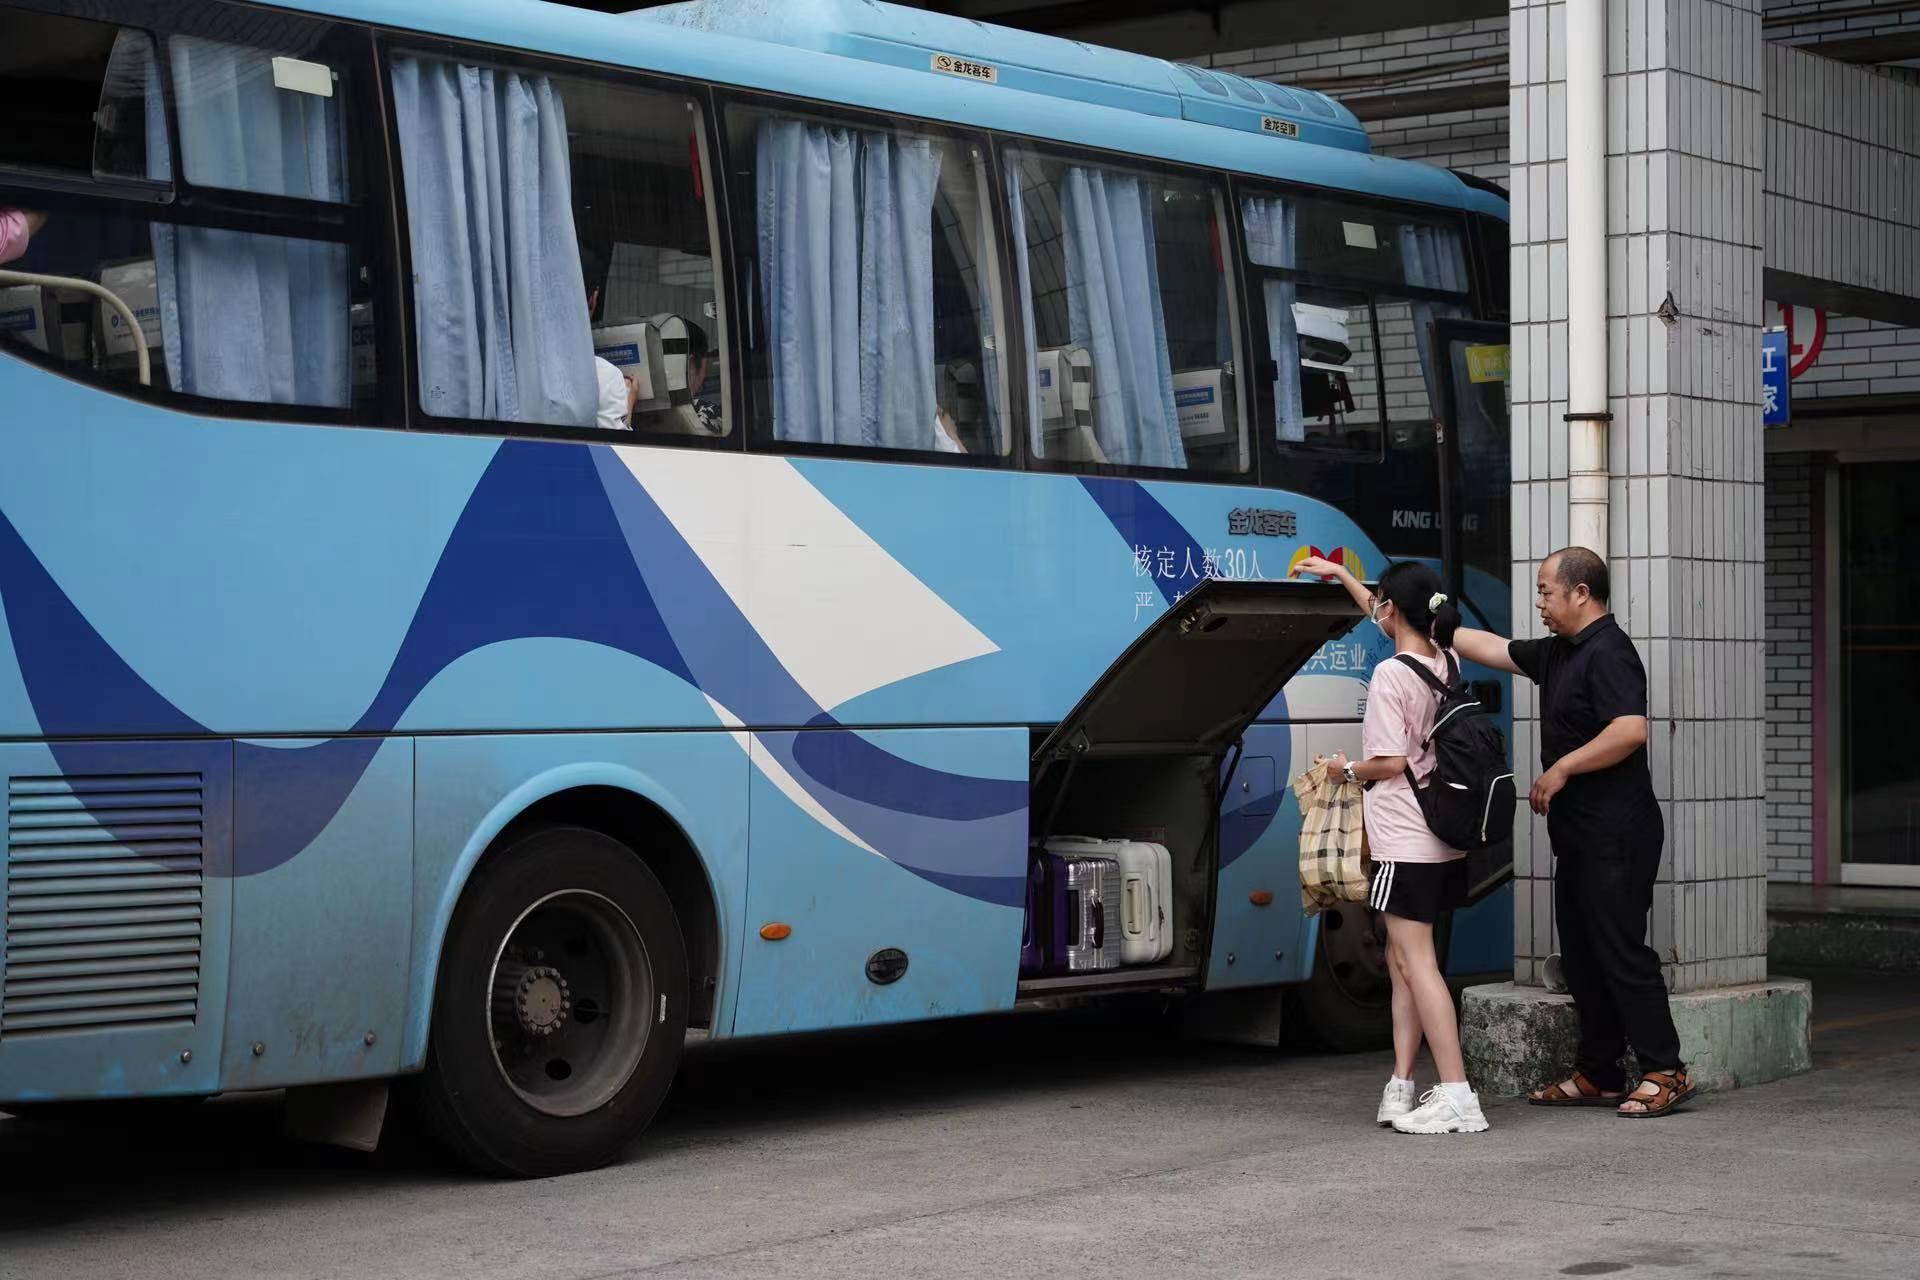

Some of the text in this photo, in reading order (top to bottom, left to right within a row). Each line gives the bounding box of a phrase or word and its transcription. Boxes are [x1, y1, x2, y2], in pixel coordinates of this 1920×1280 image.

[953, 60, 991, 79] 金龙客车
[1264, 118, 1297, 137] 金龙空调
[1228, 507, 1297, 538] 金龙客车
[1391, 509, 1480, 532] KING LG
[1132, 544, 1265, 579] 核定人数30人
[1302, 643, 1367, 671] 兴运业
